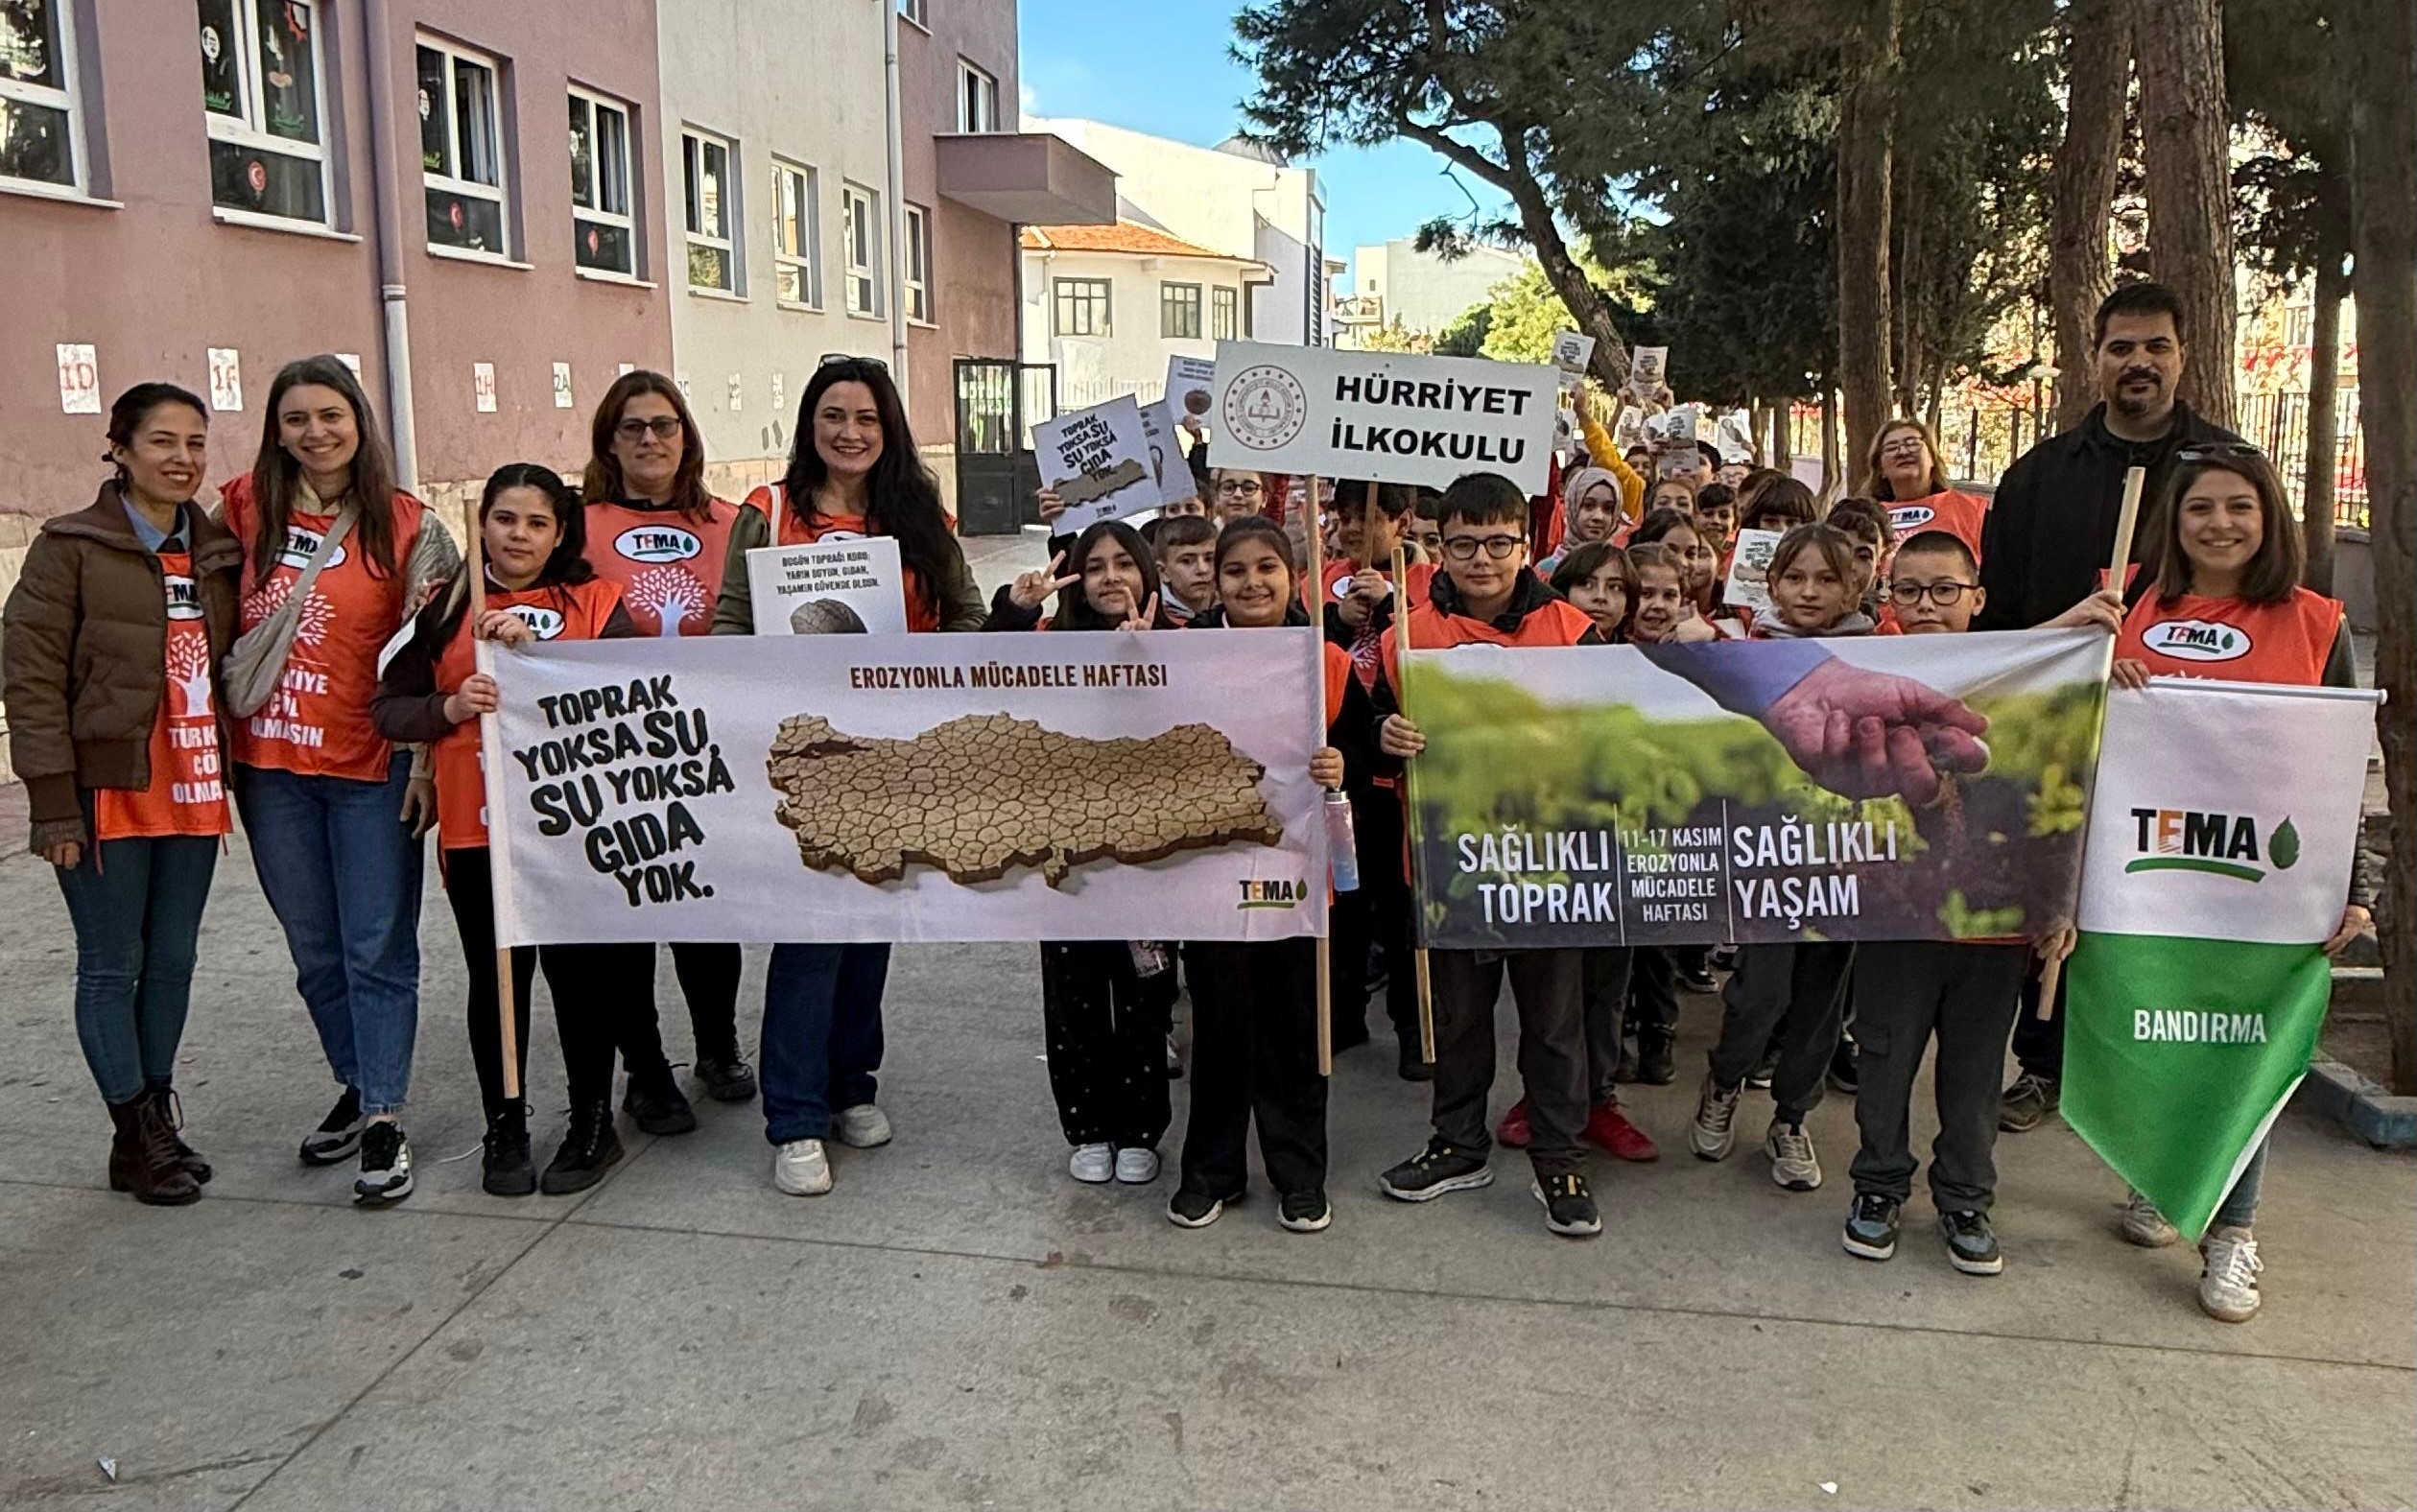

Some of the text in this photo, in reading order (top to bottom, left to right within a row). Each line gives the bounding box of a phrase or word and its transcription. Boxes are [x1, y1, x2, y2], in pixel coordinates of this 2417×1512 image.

[1335, 372, 1532, 415] HÜRRİYET
[1061, 413, 1098, 437] TOPRAK
[1331, 416, 1525, 464] İLKOKULU
[1056, 430, 1091, 455] YOKSA
[1063, 430, 1118, 468] SU YOKSA
[632, 533, 681, 550] TEMA
[815, 579, 850, 591] GÜVENDE
[2167, 626, 2217, 646] TEMA
[850, 661, 1167, 689] EROZYONLA MÜCADELE HAFTASI
[537, 674, 677, 729] TOPRAK
[168, 721, 219, 749] TÜRK
[512, 708, 721, 782] YOKSA SU,
[171, 779, 224, 804] OLMA
[530, 758, 736, 837] SU YOKSA
[585, 800, 706, 874] GIDA
[1457, 823, 1609, 873] SAĞLIKLI
[1623, 827, 1722, 848] 11-17 KASIM
[1733, 815, 1897, 868] SAĞLIKLI
[2130, 808, 2260, 862] TEMA
[1626, 853, 1719, 873] EROZYONLA
[614, 861, 715, 907] YOK.
[1238, 880, 1293, 901] TEMA
[1631, 875, 1717, 898] MÜCADELE
[1478, 882, 1616, 924] TOPRAK
[1643, 903, 1708, 923] HAFTASI
[1734, 874, 1860, 930] YAŞAM
[2133, 1010, 2267, 1044] BANDIRMA
